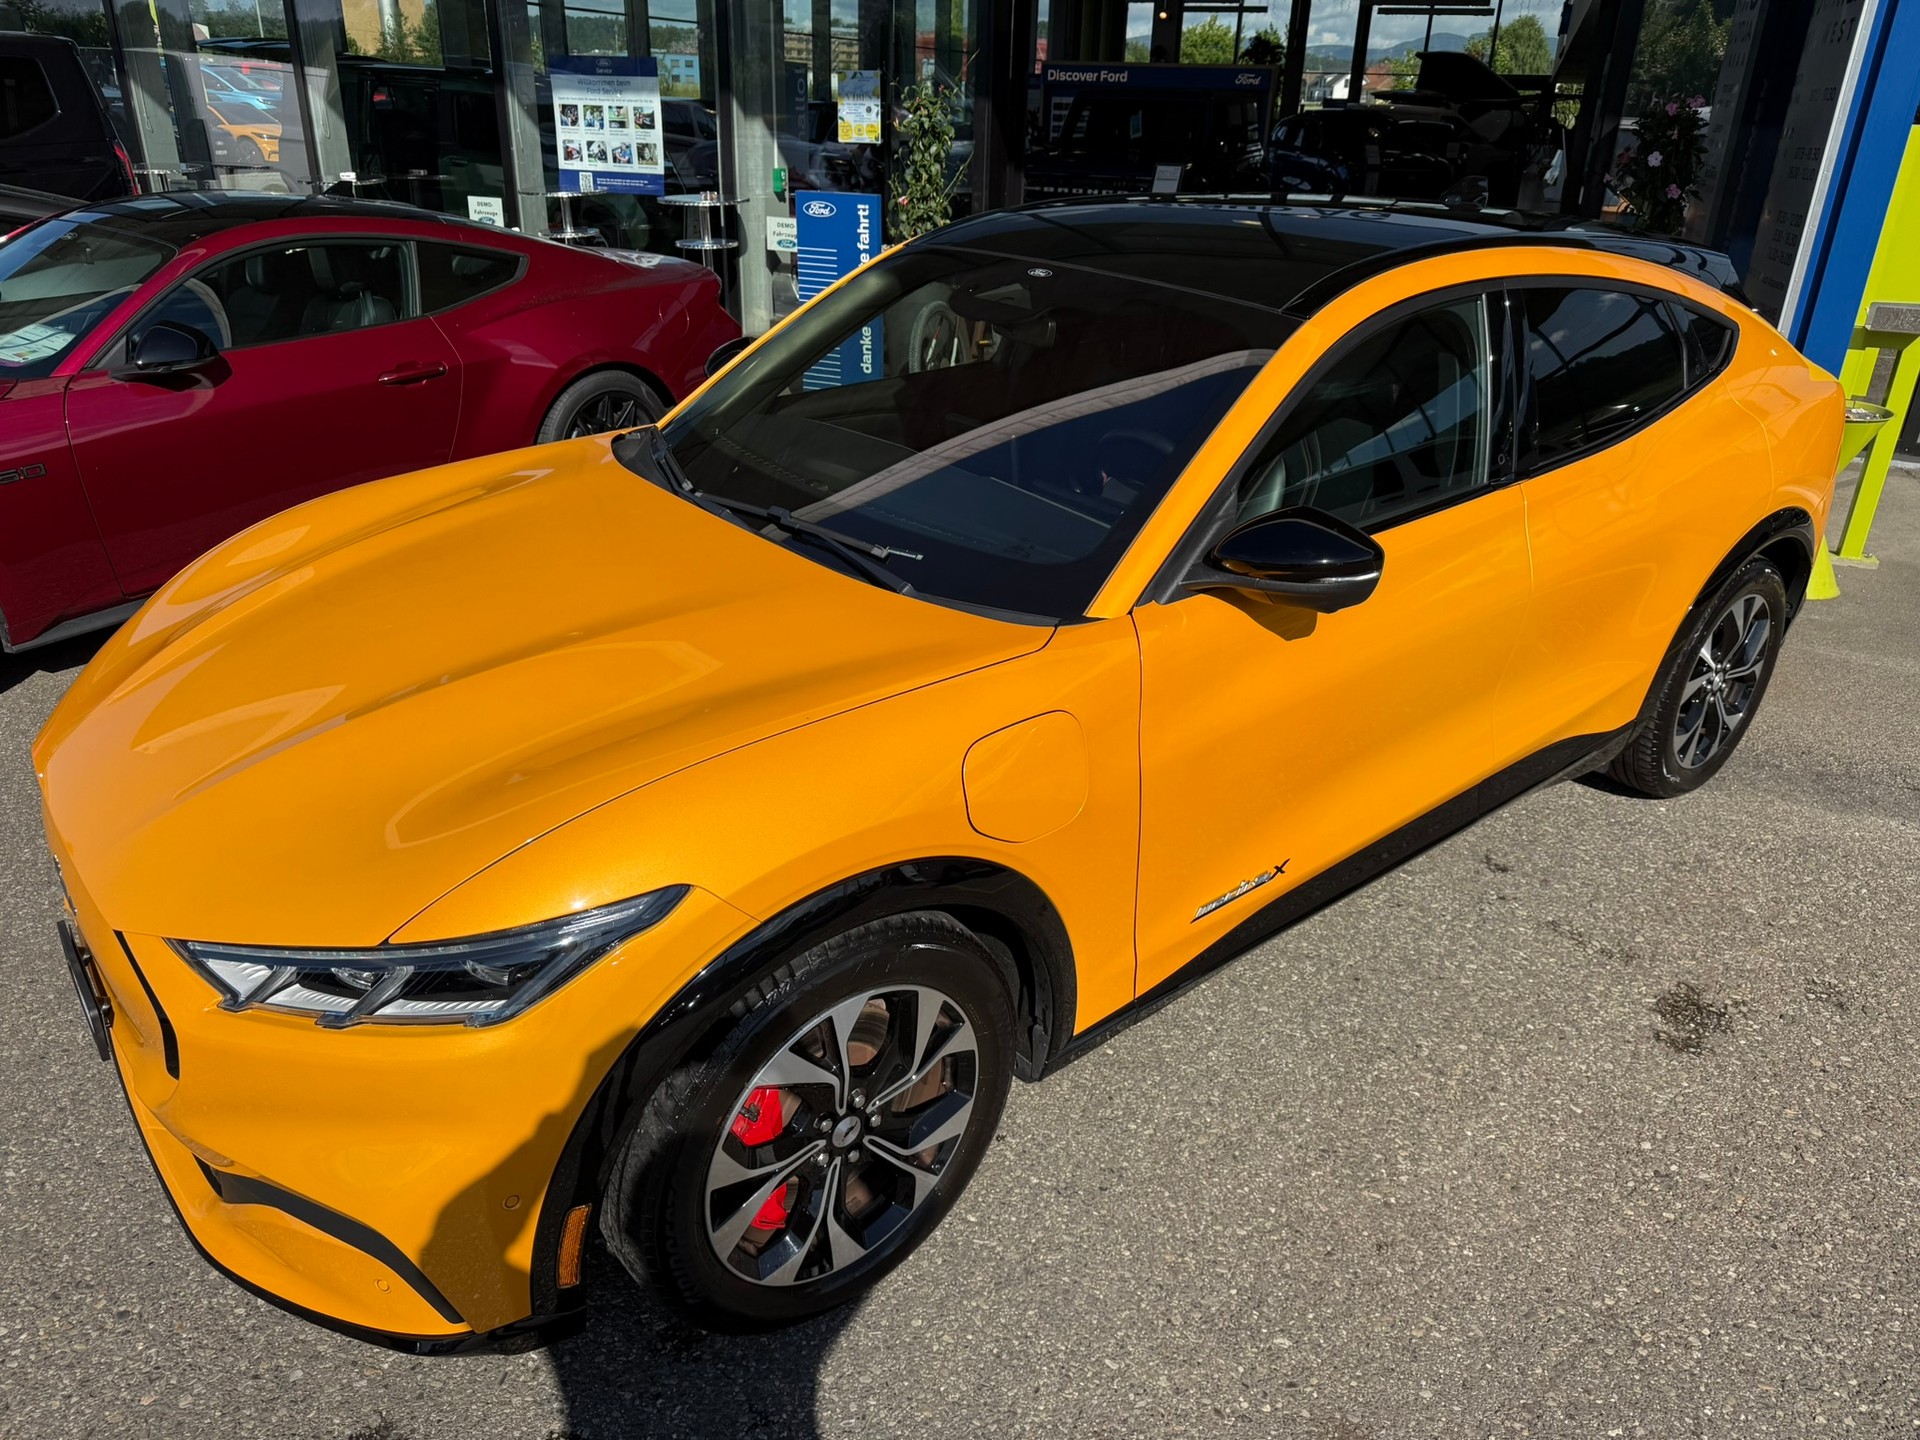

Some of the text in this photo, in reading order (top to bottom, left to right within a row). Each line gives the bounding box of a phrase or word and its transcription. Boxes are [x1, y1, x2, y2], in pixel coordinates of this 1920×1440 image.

[1047, 69, 1128, 82] Discover Ford
[1235, 73, 1262, 85] Ford
[577, 78, 632, 87] Willkommen beim
[602, 87, 623, 95] Service
[806, 202, 833, 216] Ford
[857, 204, 870, 249] fahrt!
[773, 231, 797, 239] Fahrzeug
[859, 326, 872, 374] danke
